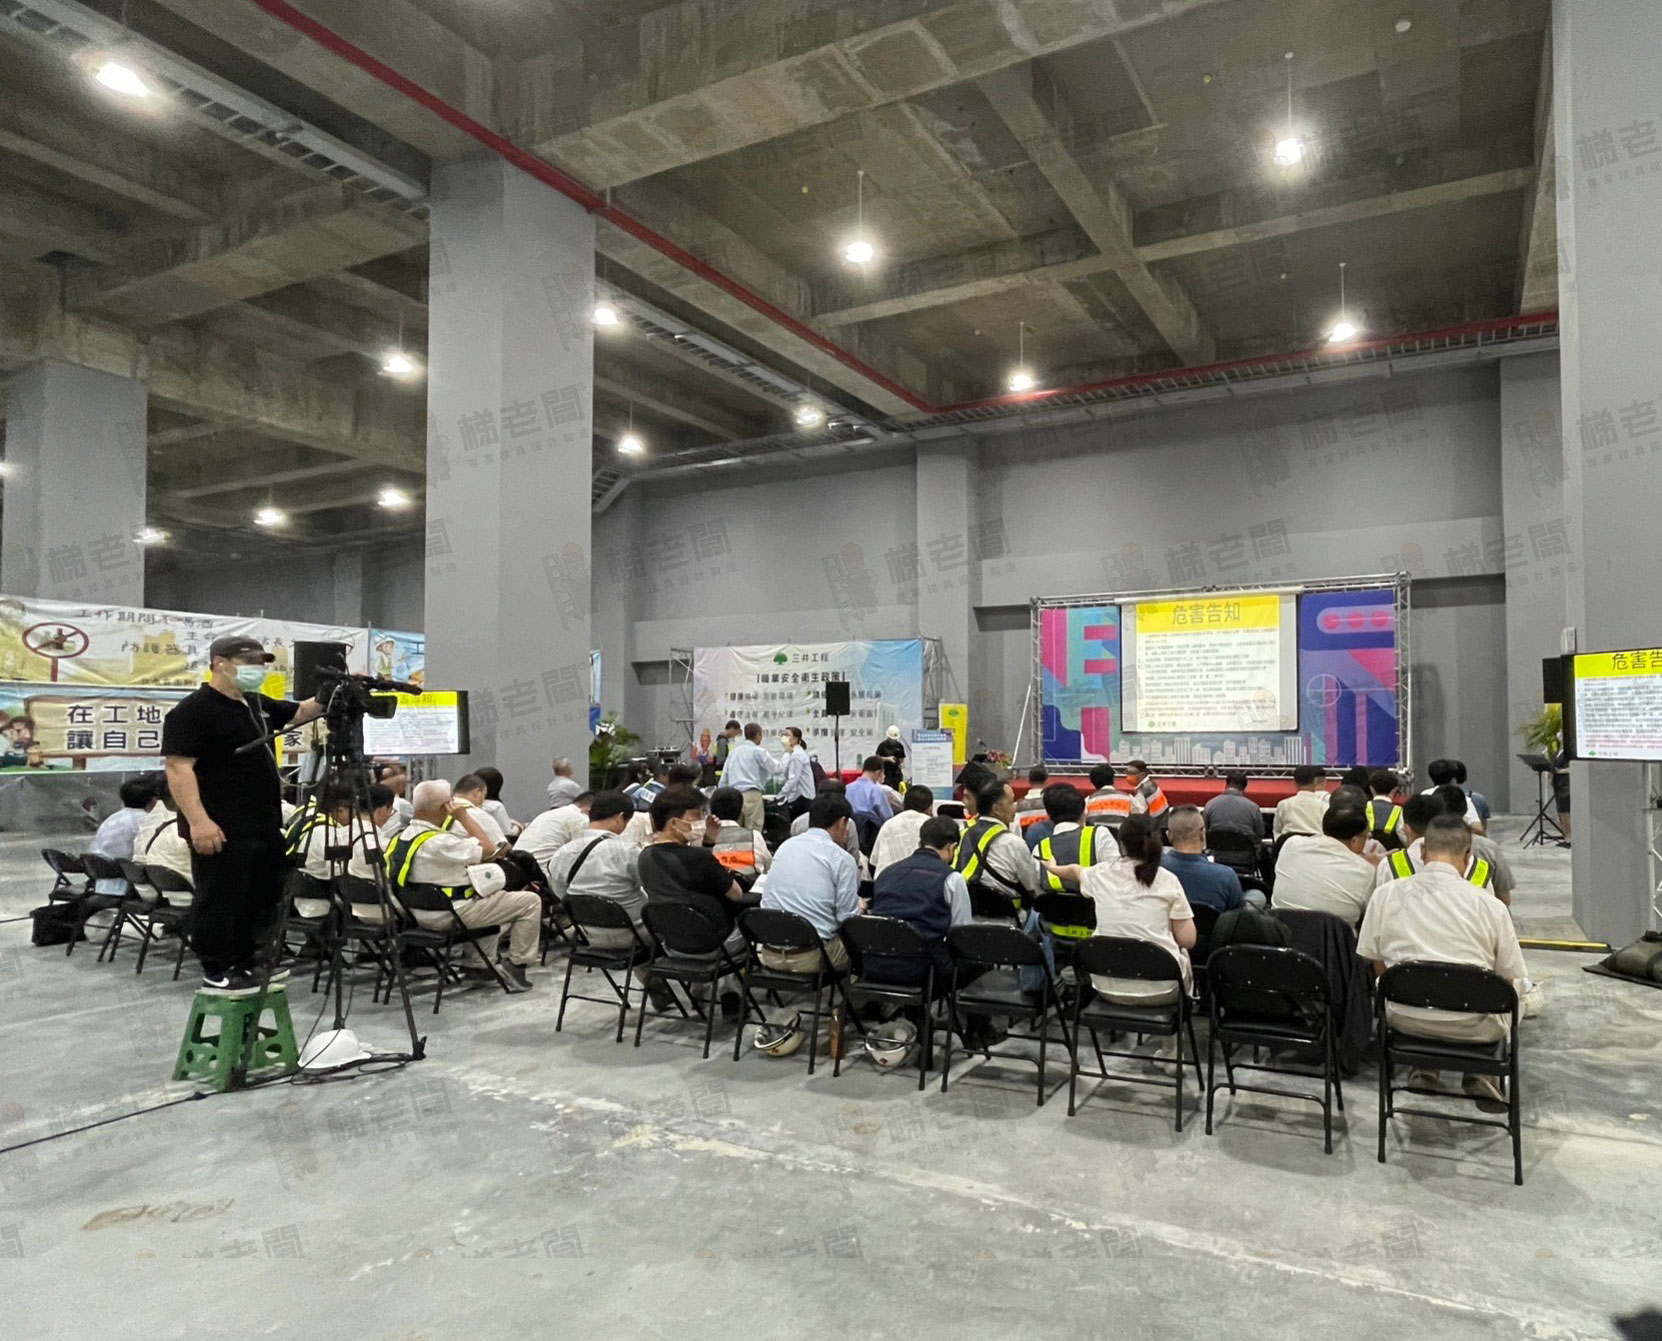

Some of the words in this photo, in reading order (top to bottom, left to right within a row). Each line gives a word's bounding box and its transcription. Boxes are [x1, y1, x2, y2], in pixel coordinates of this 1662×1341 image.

[1172, 601, 1241, 626] 危害告知
[792, 653, 829, 663] 三井工程
[67, 705, 162, 724] 在工地
[66, 730, 161, 750] 讓自己
